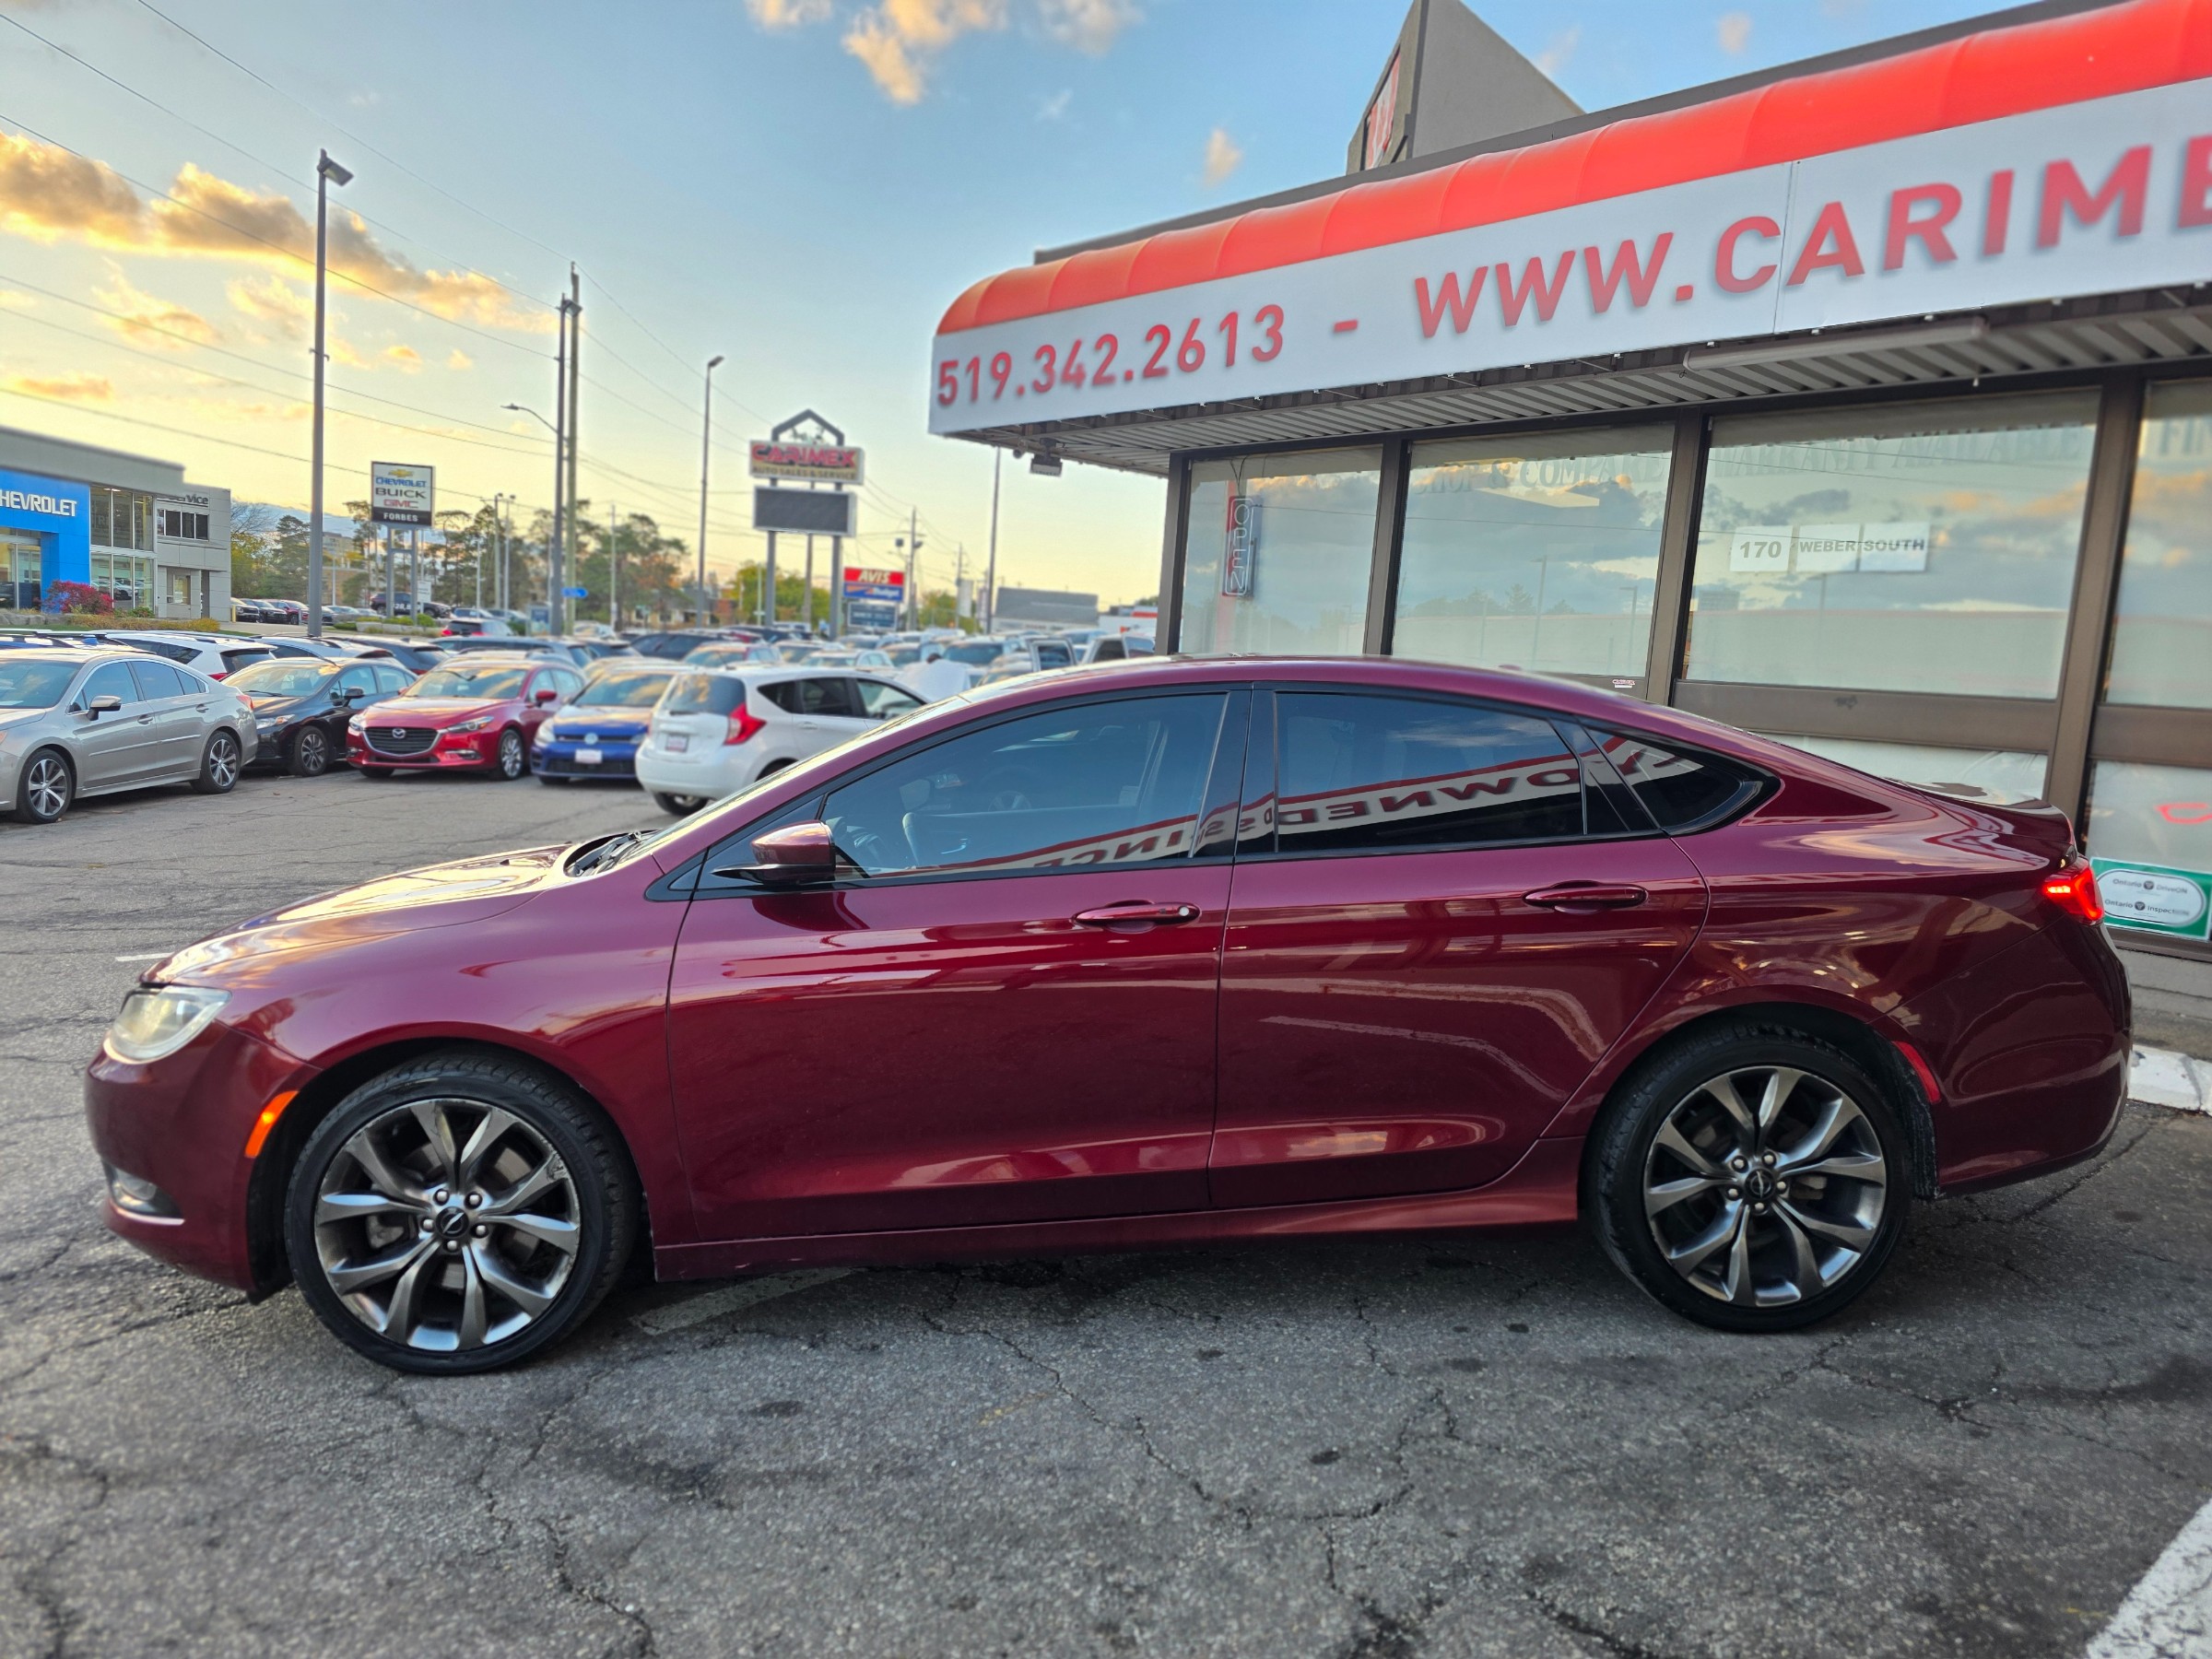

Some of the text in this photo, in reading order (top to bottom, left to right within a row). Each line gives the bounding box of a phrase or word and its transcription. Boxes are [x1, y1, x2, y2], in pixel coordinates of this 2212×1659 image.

[936, 303, 1283, 406] 519.342.2613
[751, 444, 856, 468] CARIMEX
[1487, 460, 1512, 488] &
[1522, 452, 1665, 488] COMPARE
[375, 477, 428, 488] CHEVROLET
[375, 488, 427, 500] BUICK
[383, 499, 418, 509] GMC
[383, 512, 418, 523] FORBES
[1230, 503, 1250, 591] OPEN
[1739, 538, 1925, 559] 170 WEBER SOUTH
[857, 569, 890, 584] AVIS
[2112, 878, 2188, 895] Ontario DriveON
[2104, 899, 2134, 909] Ontario
